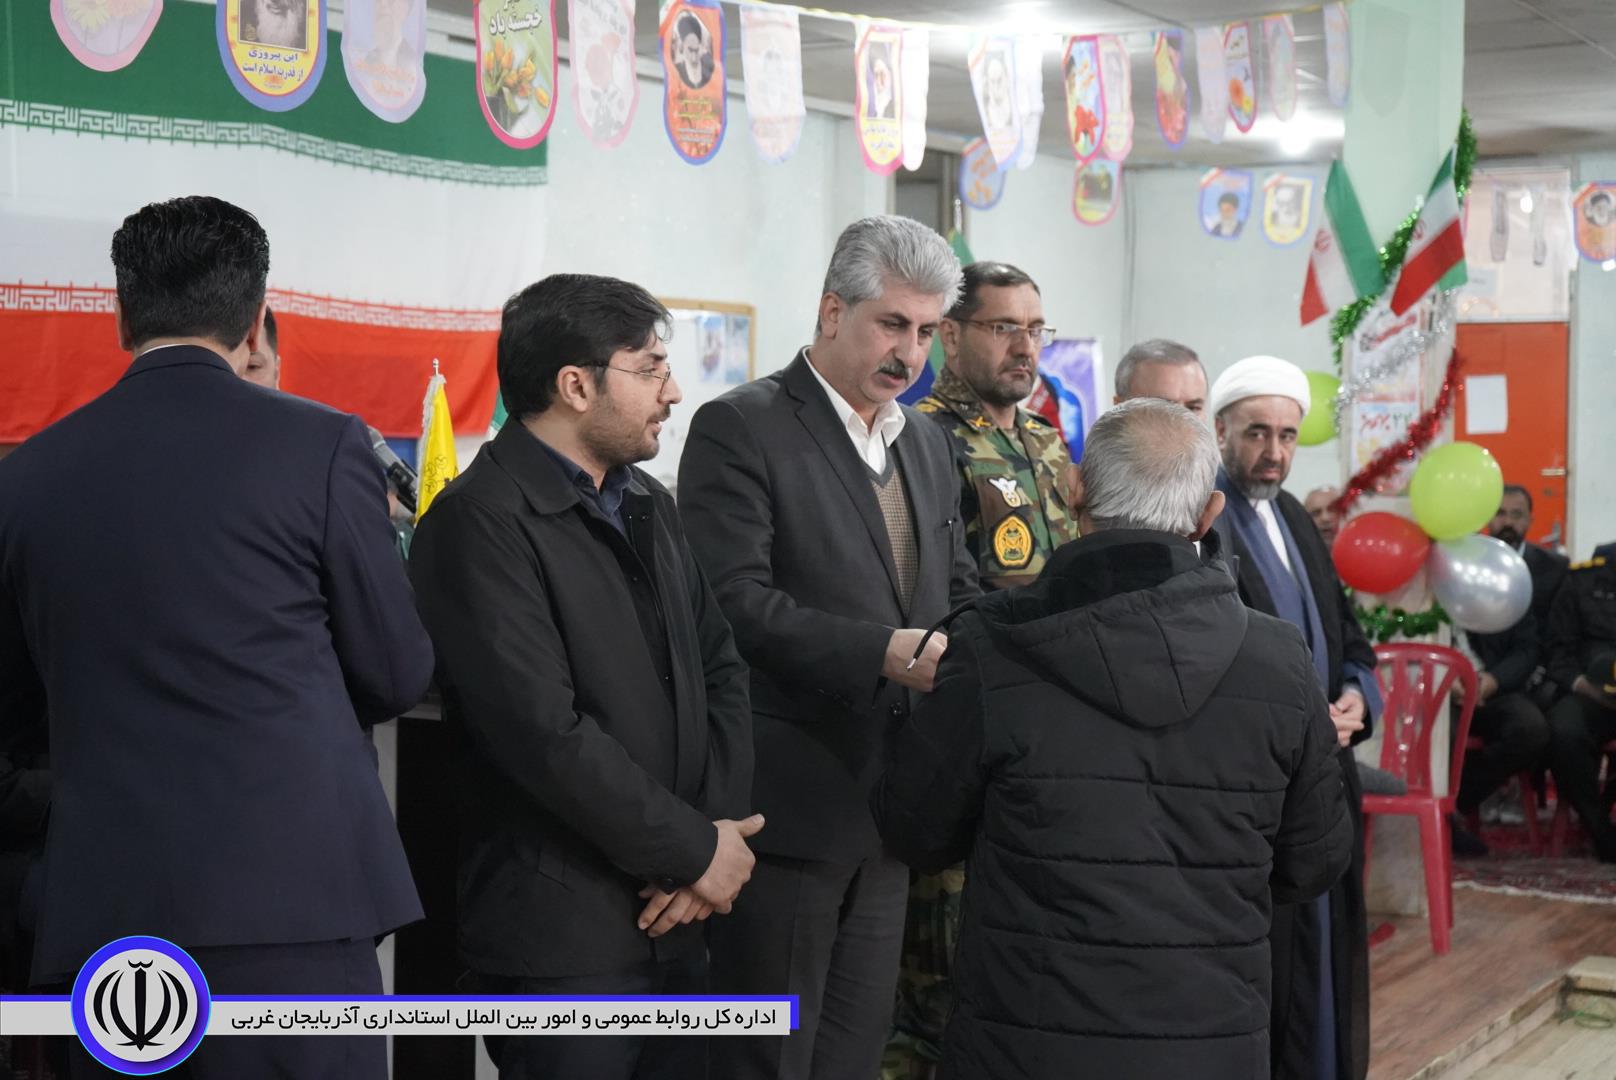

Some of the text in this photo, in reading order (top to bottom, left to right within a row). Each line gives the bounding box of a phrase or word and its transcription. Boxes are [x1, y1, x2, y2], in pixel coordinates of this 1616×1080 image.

[489, 6, 542, 40] خجسته باد
[248, 48, 299, 63] این پیروزی
[242, 61, 258, 73] است
[258, 62, 277, 75] اسلام
